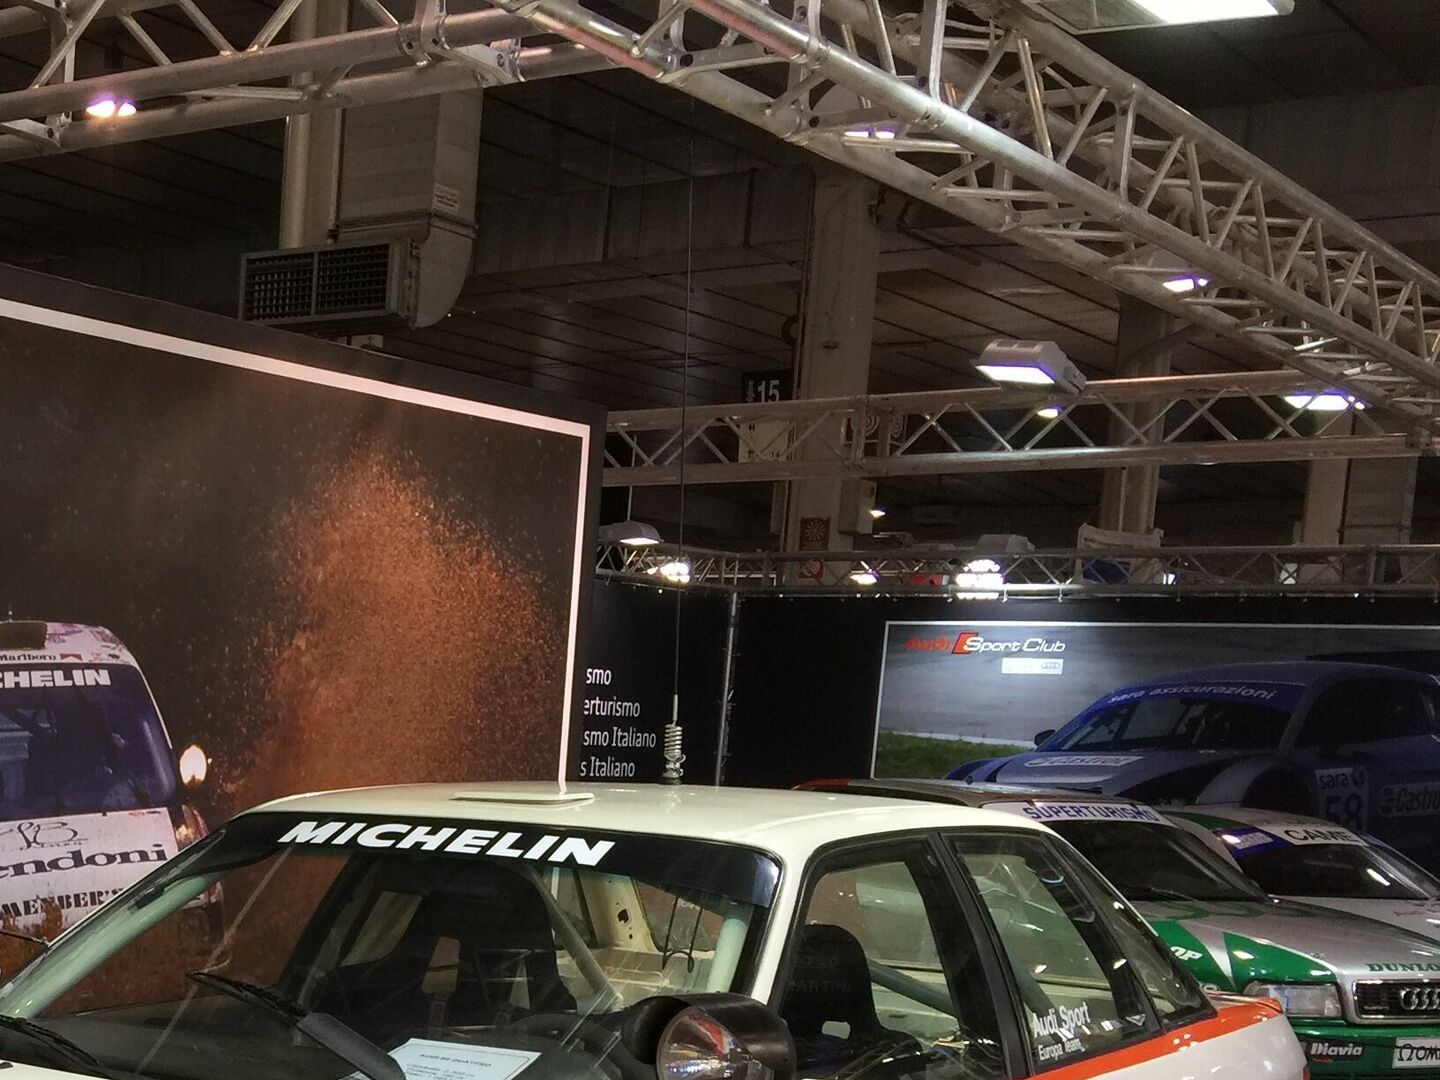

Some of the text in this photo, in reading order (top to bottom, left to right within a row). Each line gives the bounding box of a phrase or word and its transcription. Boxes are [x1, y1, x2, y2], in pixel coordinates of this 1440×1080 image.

[962, 636, 1021, 654] Sport
[1022, 637, 1066, 652] Club
[1148, 684, 1279, 701] assicurazioni
[611, 726, 657, 748] Italiano
[589, 756, 636, 778] Italiano
[277, 820, 616, 867] MICHELIN
[1032, 1001, 1091, 1039] Audi Sport
[1038, 1042, 1064, 1061] Europa
[1310, 1042, 1363, 1056] Diavia
